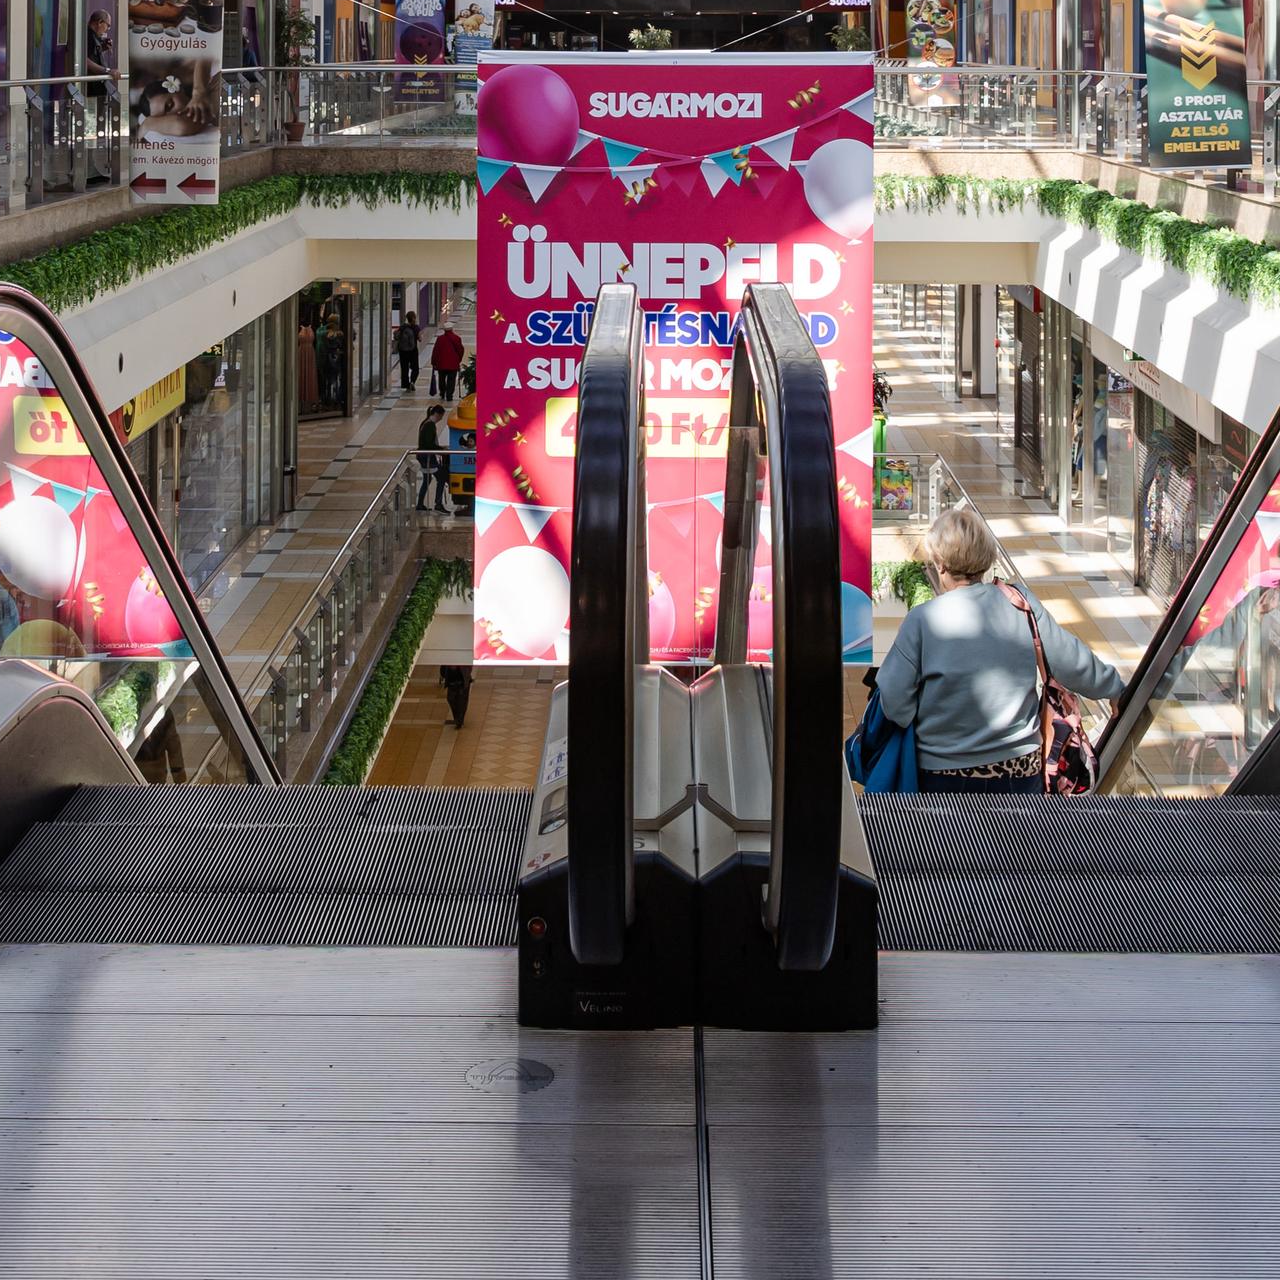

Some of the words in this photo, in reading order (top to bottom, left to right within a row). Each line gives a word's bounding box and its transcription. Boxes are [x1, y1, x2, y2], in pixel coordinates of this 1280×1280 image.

[140, 37, 207, 51] Gyógyulás
[1174, 96, 1181, 106] 8
[1185, 95, 1226, 106] PROFI
[1159, 110, 1209, 122] ASZTAL
[1210, 108, 1243, 120] VÁR
[1171, 127, 1190, 138] AZ
[1194, 124, 1228, 136] ELSŐ
[1164, 140, 1240, 153] EMELETEN!
[153, 156, 185, 165] Kávézó
[507, 225, 841, 299] ÜNNEPELD
[504, 323, 522, 343] A
[504, 368, 522, 388] A
